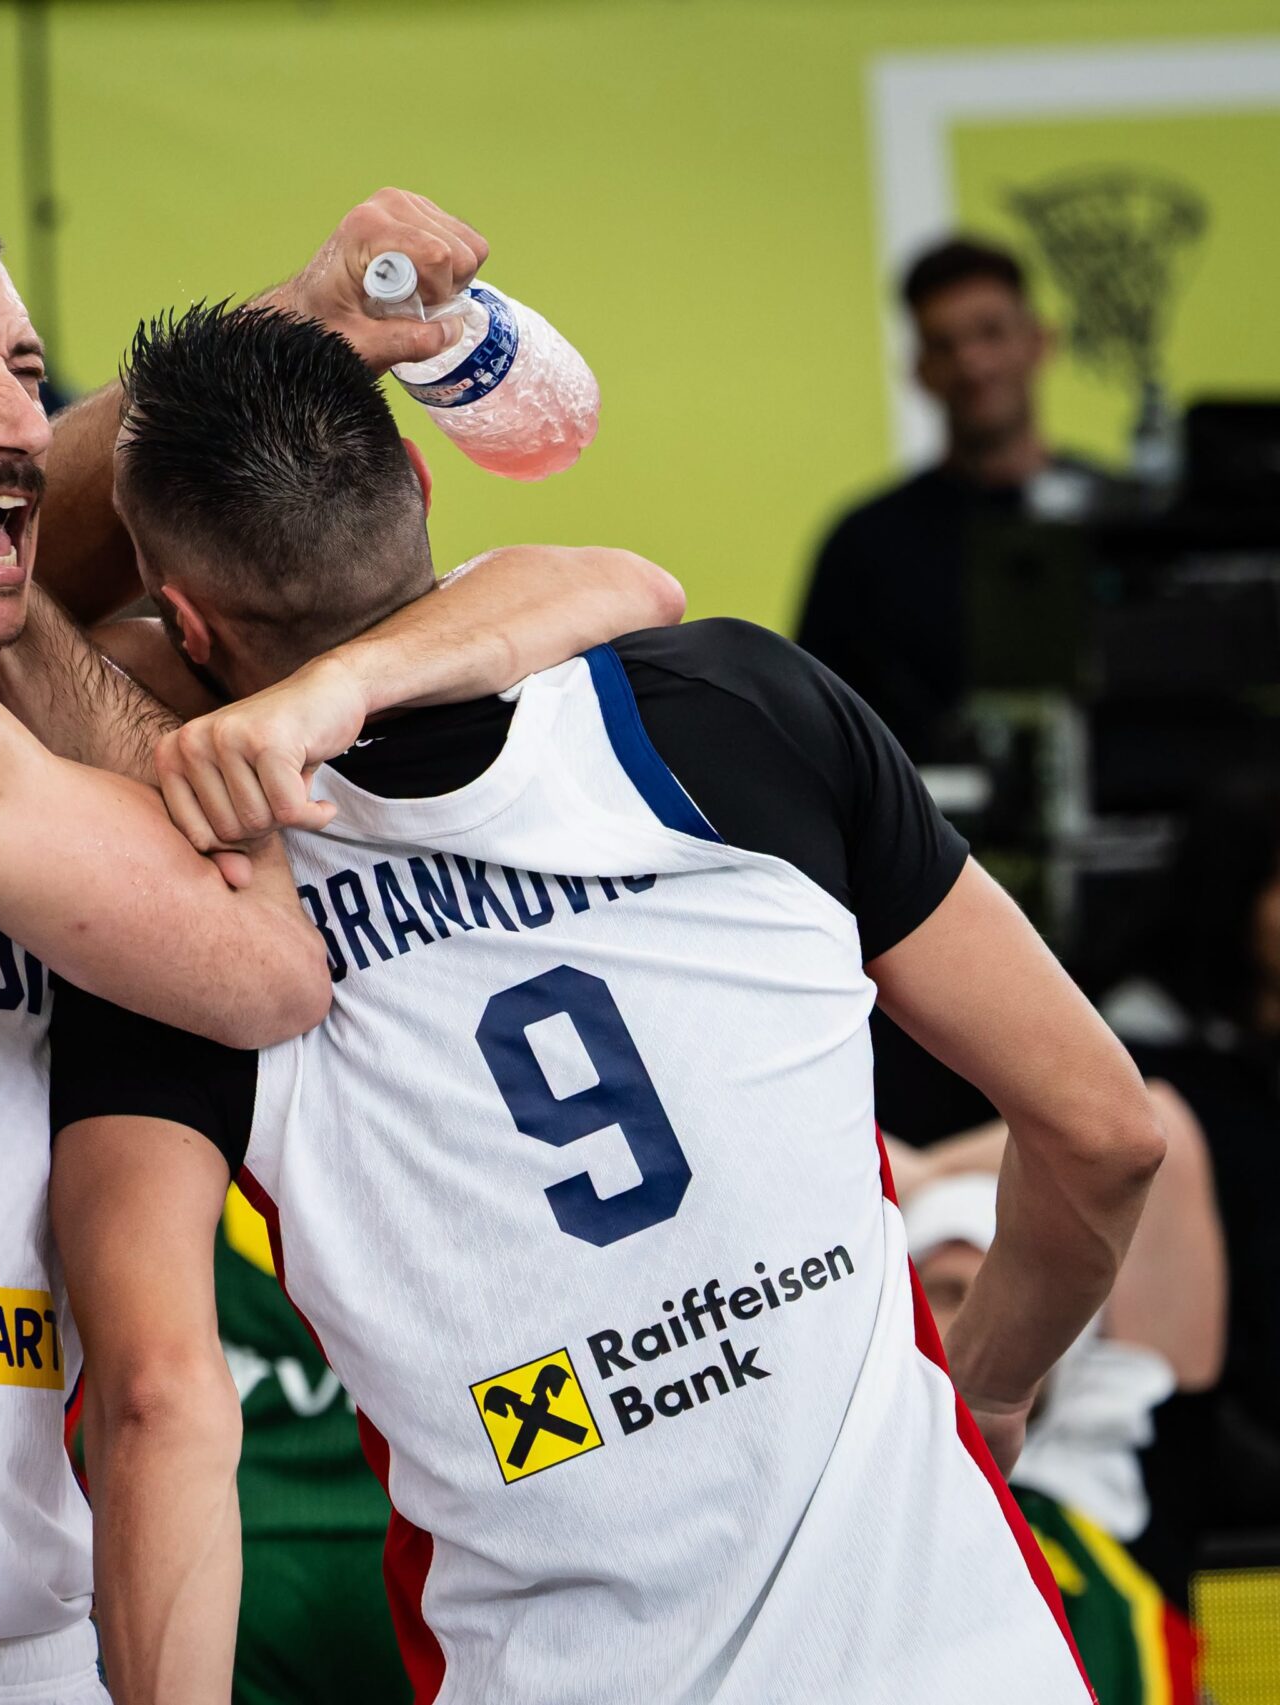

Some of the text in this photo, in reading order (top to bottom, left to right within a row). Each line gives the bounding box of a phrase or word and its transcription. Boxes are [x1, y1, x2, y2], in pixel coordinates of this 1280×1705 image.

[297, 852, 657, 983] BRANKO
[475, 963, 693, 1248] 9
[587, 1244, 855, 1381] Raiffeisen
[609, 1338, 772, 1437] Bank
